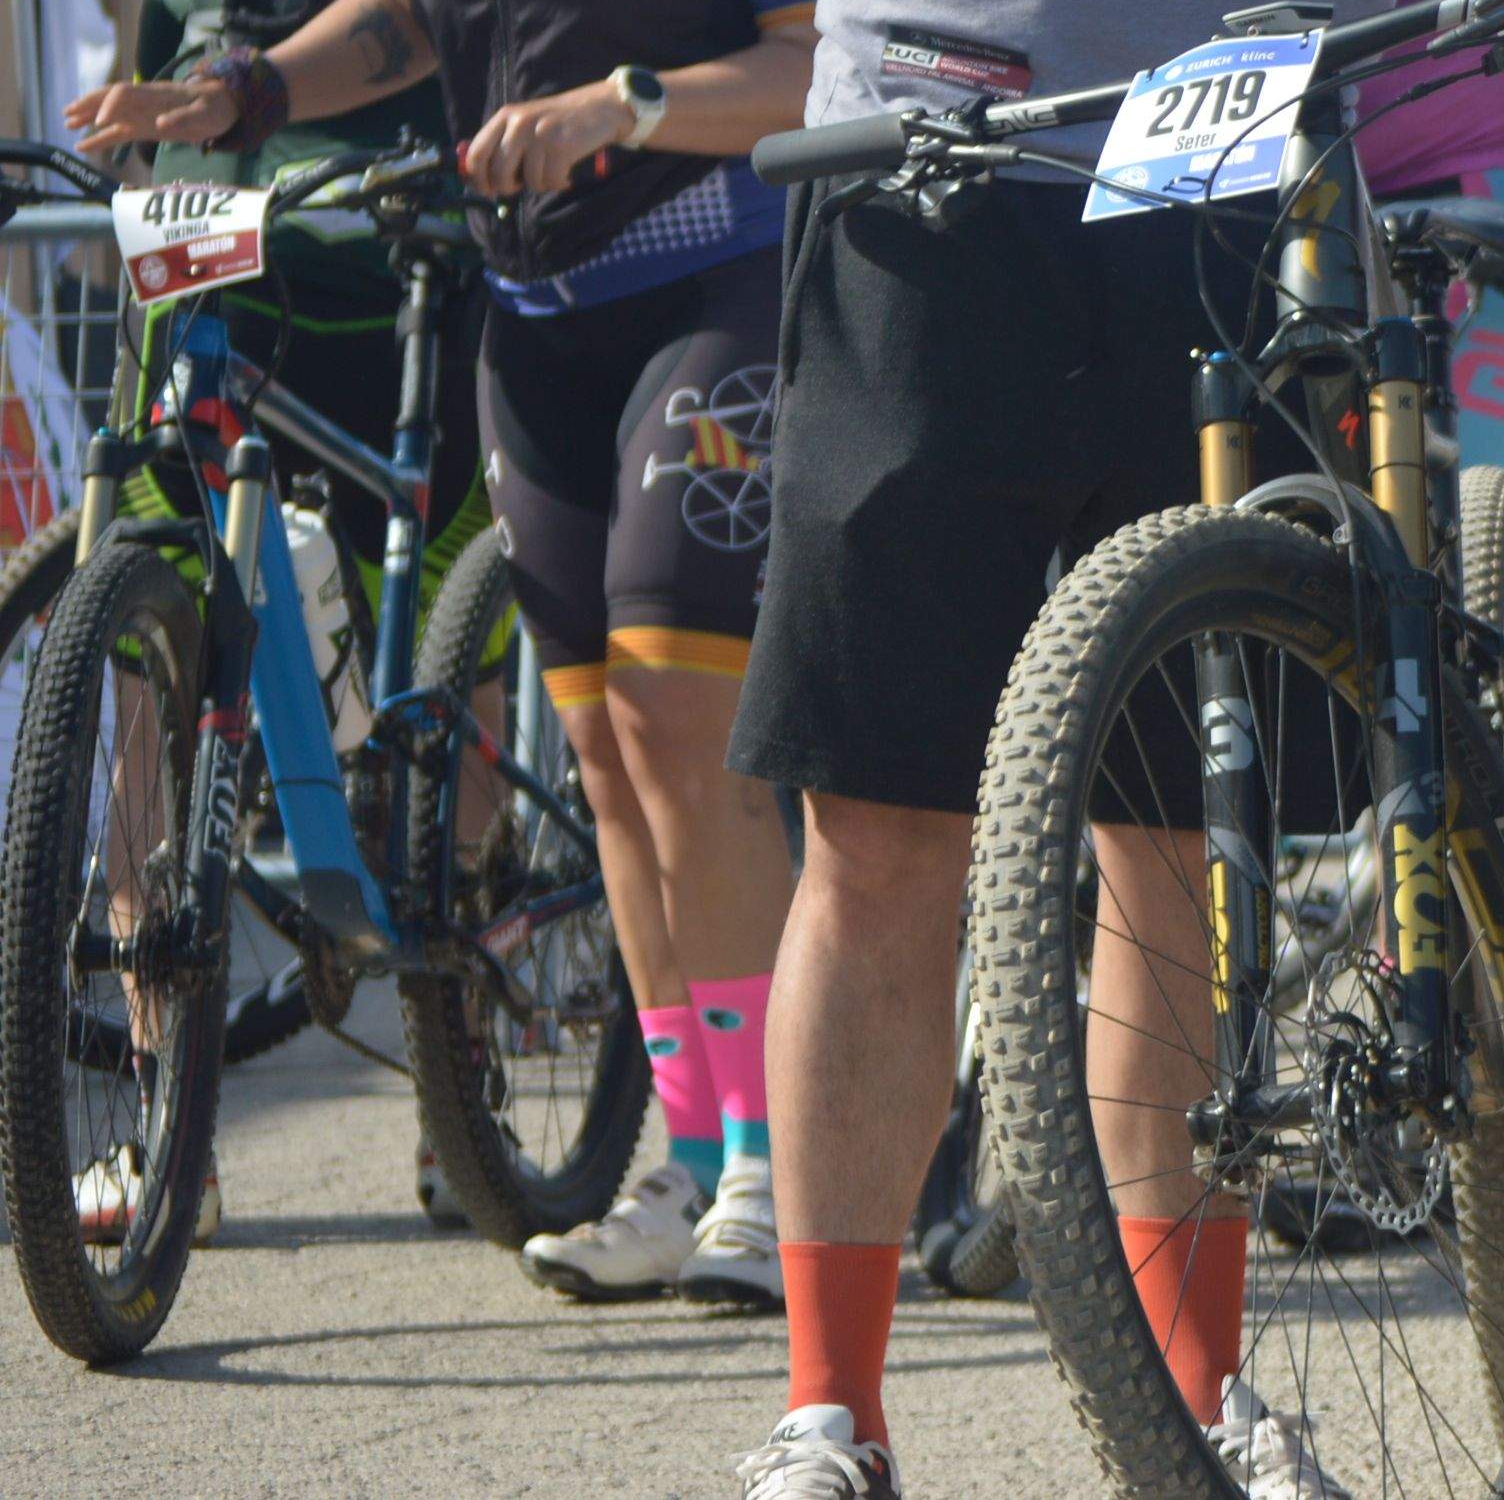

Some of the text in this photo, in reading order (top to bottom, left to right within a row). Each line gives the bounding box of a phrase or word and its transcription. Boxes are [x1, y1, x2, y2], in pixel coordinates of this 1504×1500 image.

[895, 47, 937, 66] UCI
[1185, 55, 1234, 75] ZURICH
[1145, 70, 1267, 139] 2719
[142, 188, 240, 226] 4102
[1394, 823, 1446, 976] FOX
